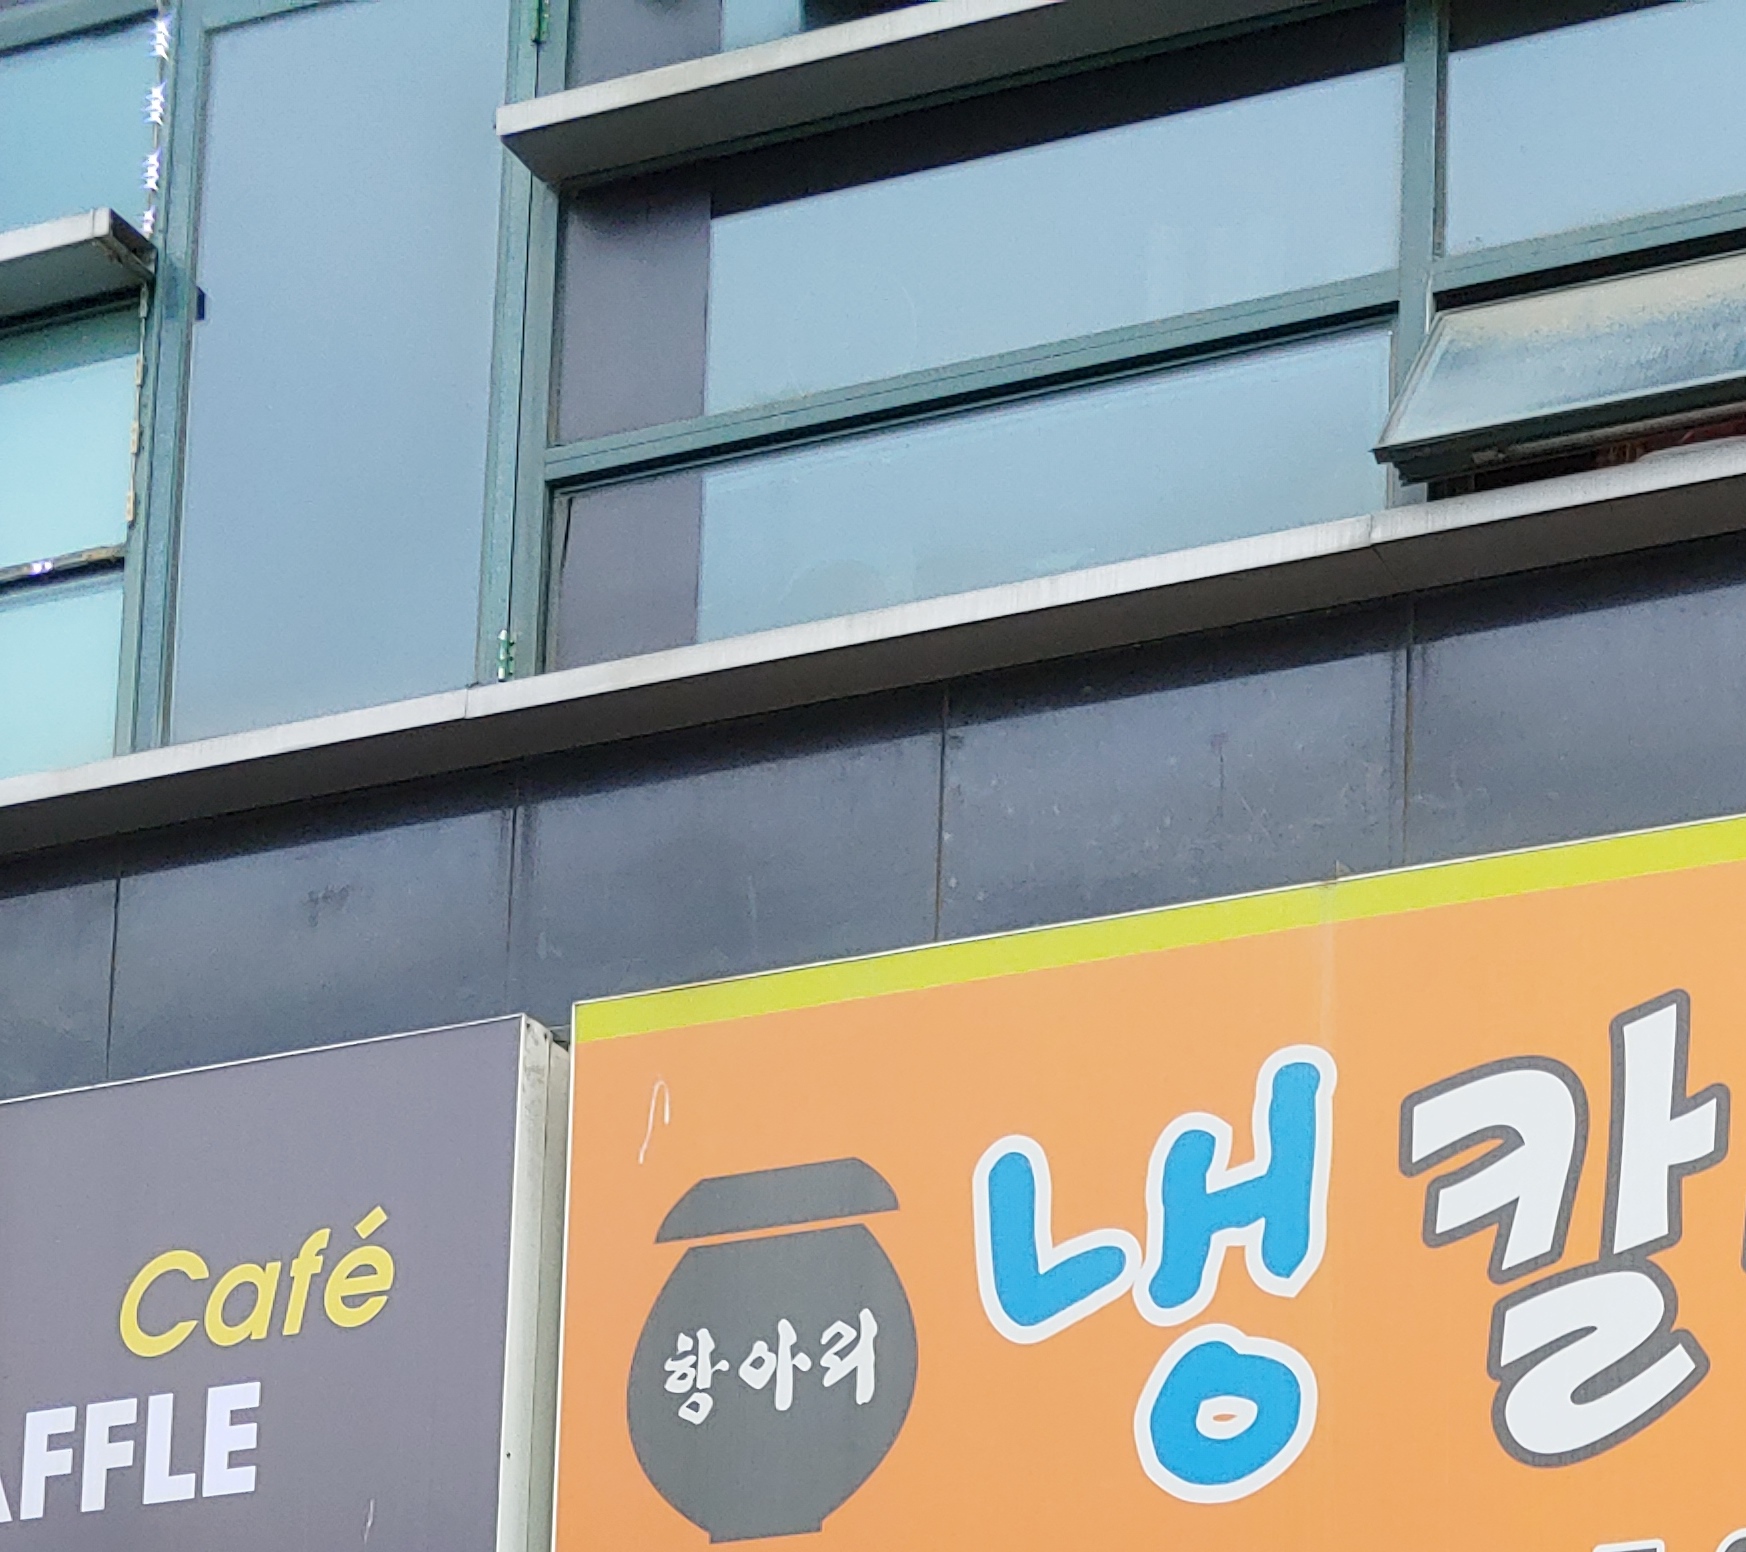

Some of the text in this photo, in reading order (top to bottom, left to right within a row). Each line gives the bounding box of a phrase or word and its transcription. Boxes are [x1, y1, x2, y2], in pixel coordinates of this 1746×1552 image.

[119, 1205, 396, 1358] Café
[663, 1306, 880, 1425] 항아리
[0, 1381, 262, 1524] FFLE
